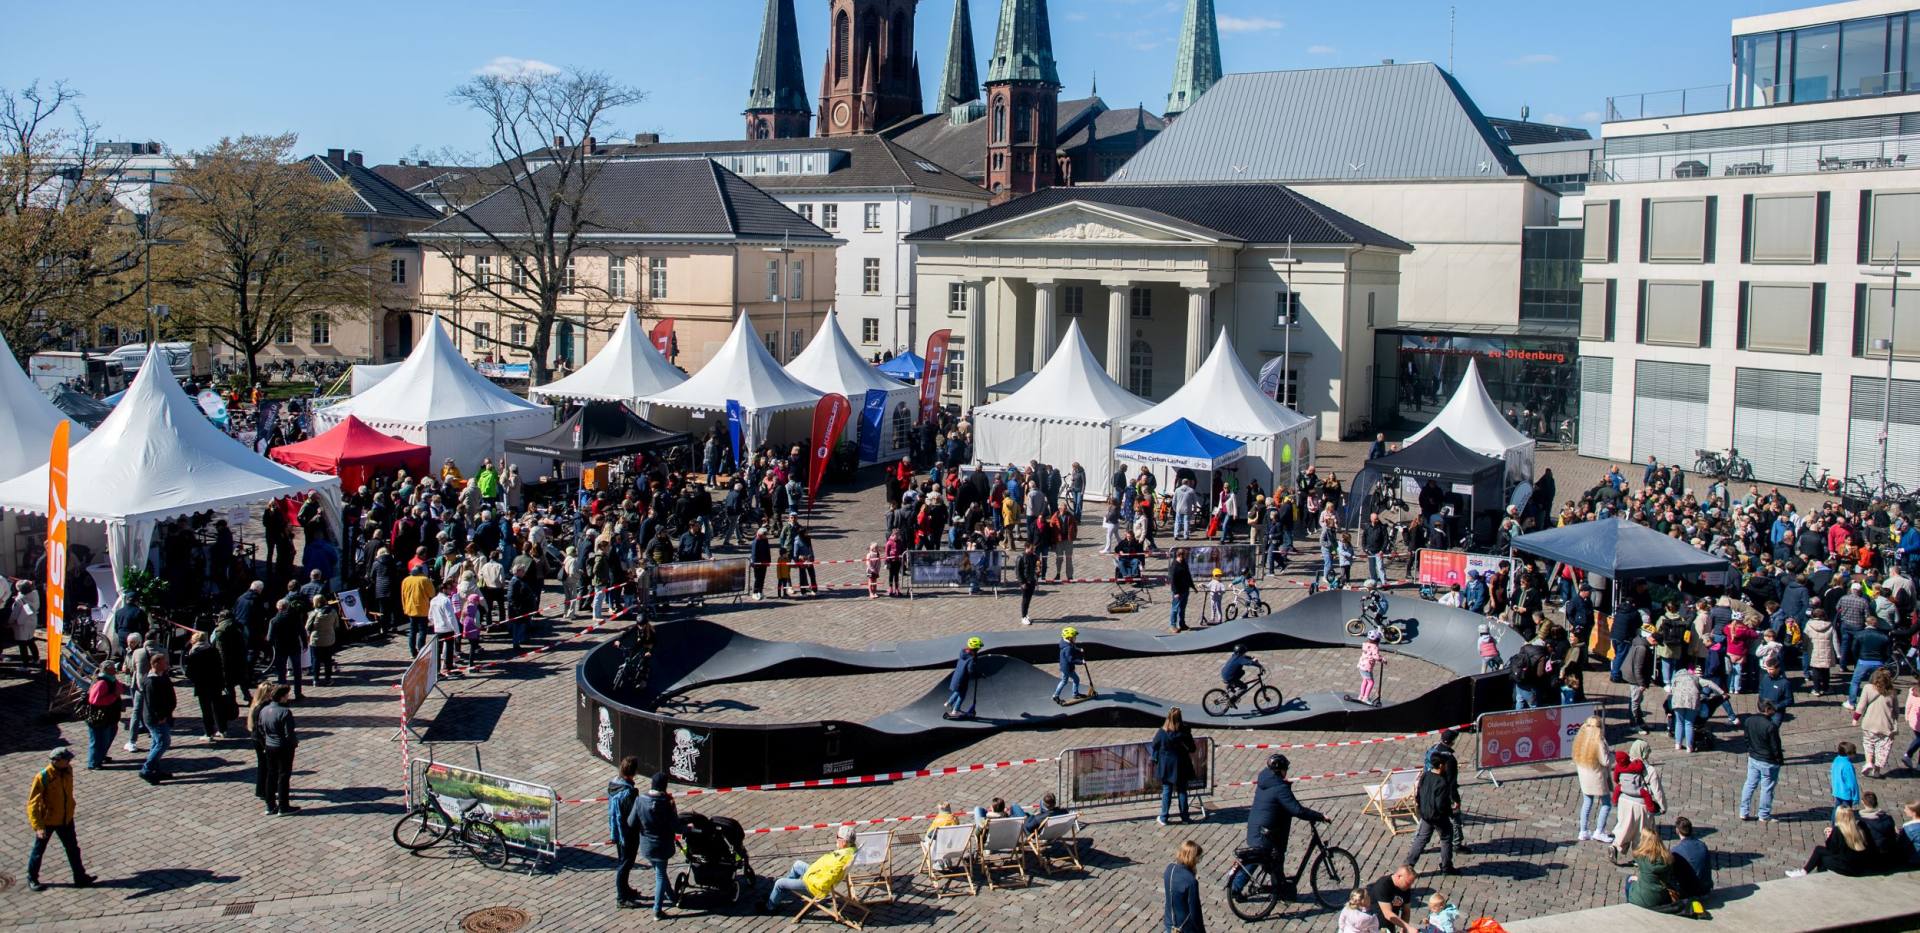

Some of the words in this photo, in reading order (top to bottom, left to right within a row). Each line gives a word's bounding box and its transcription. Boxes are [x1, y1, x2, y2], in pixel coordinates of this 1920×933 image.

[1488, 349, 1502, 358] zu
[1506, 349, 1565, 363] Oldenburg
[1403, 469, 1441, 478] KALKHOFF
